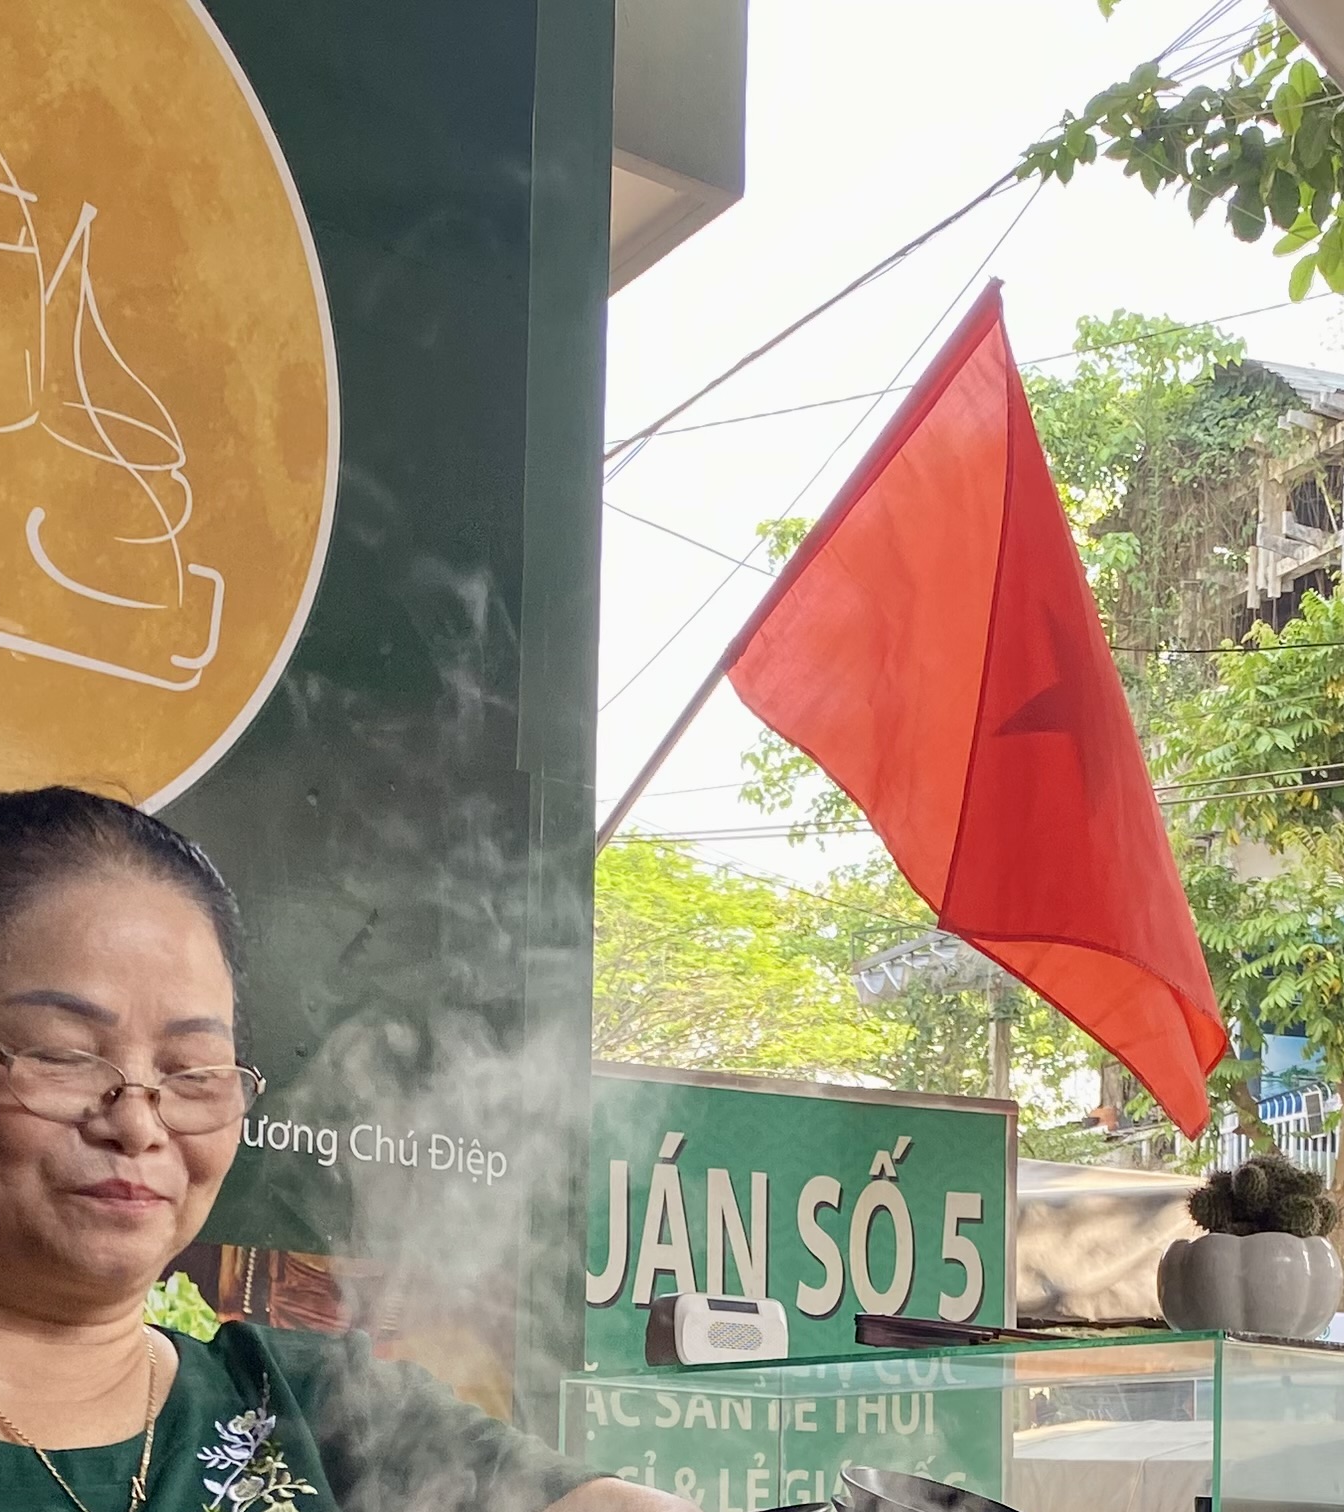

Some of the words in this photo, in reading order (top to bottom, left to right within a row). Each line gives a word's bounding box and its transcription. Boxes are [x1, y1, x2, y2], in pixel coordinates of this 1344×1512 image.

[238, 1115, 338, 1167] ương
[350, 1124, 418, 1167] Chú
[428, 1133, 507, 1185] Điệp
[586, 1132, 767, 1307] UÁN
[796, 1136, 918, 1320] SỐ
[938, 1191, 985, 1323] 5
